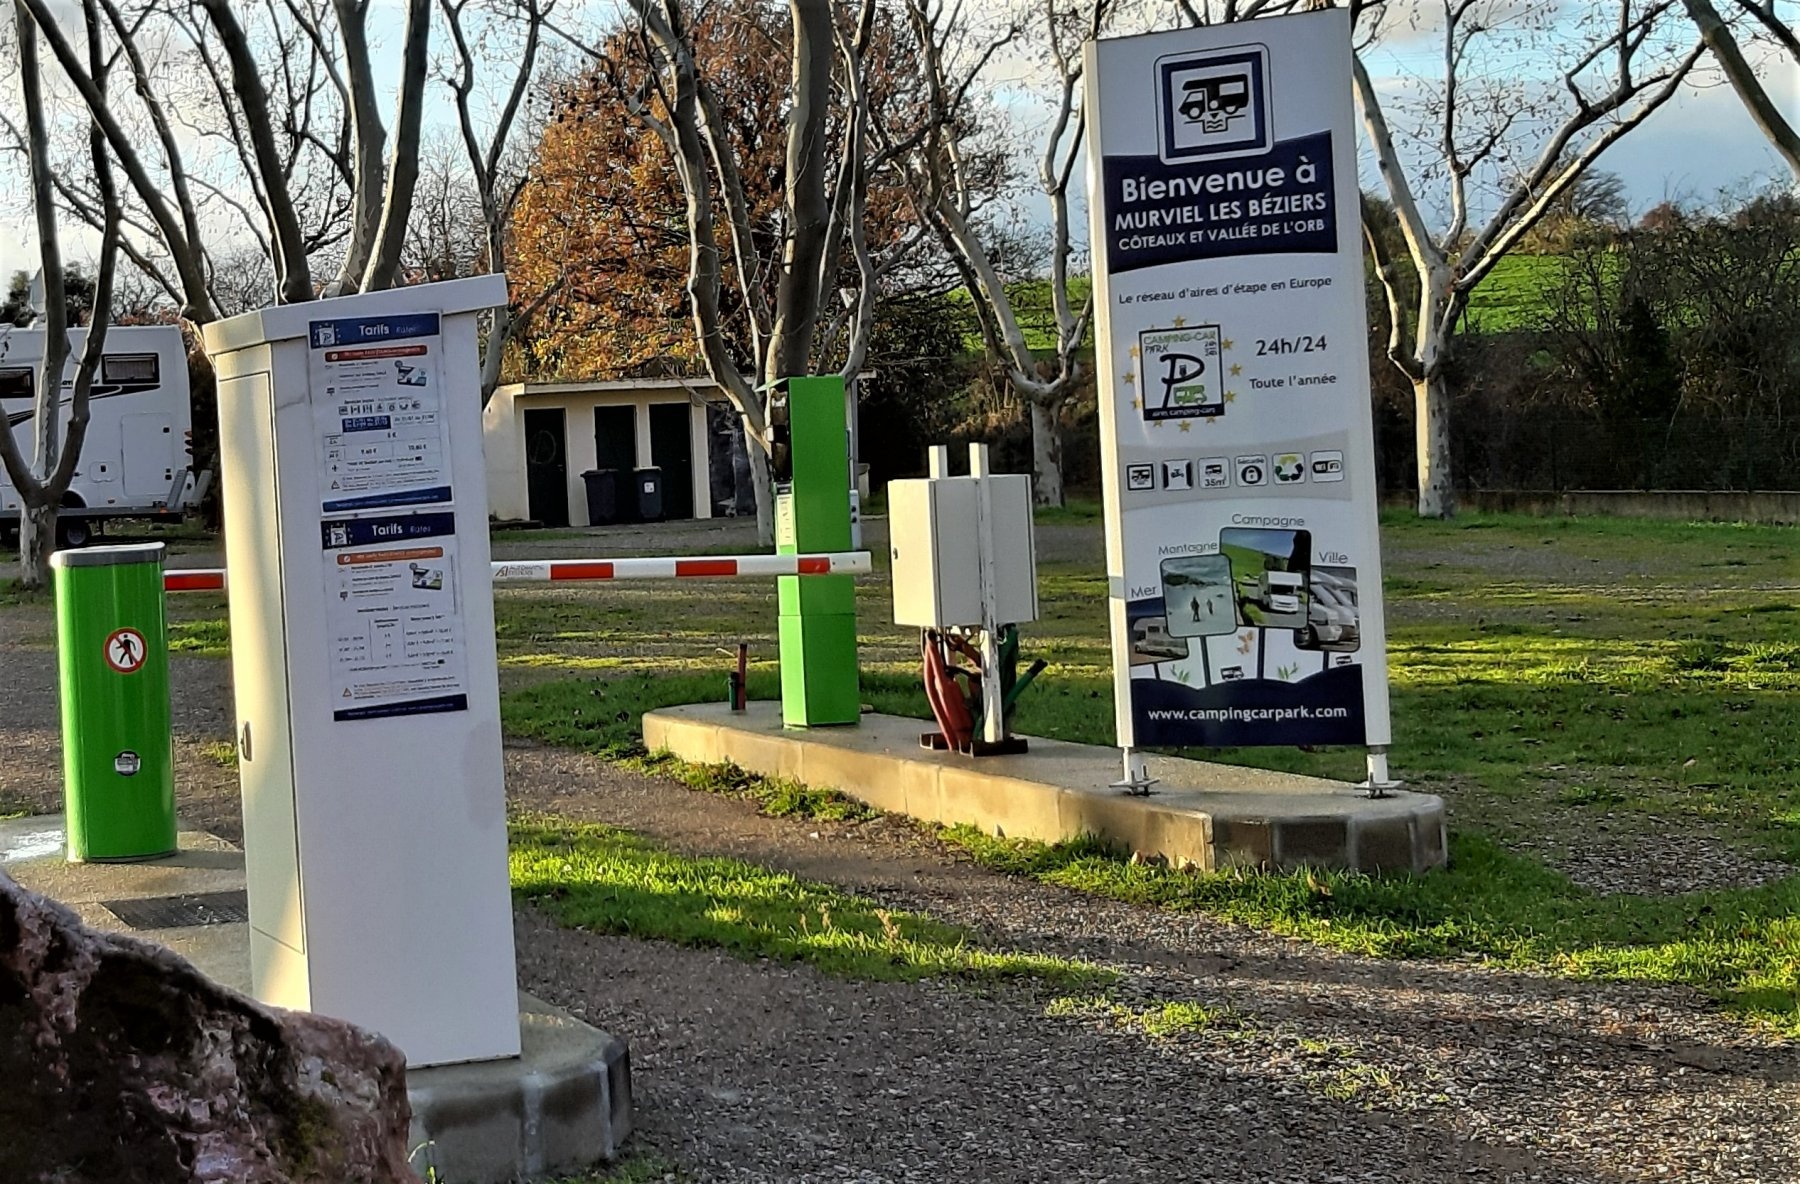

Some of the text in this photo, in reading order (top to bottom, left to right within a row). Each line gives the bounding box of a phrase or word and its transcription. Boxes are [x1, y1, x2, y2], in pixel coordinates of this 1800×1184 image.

[1122, 156, 1316, 202] Bienvenue à
[1114, 192, 1327, 231] MURVIEL LES BÉZIERS
[1118, 219, 1325, 250] CÔTEAUX ET VALLÉE DE L'ORB
[1119, 294, 1133, 304] Le
[1179, 286, 1218, 299] d'aires
[1271, 281, 1286, 291] en
[1290, 277, 1332, 290] Europe
[359, 324, 390, 336] Tarifs
[1256, 335, 1328, 356] 24h/24
[1250, 373, 1337, 390] Toute l'année
[1232, 513, 1305, 528] Campagne
[372, 523, 403, 536] Tarifs
[1158, 541, 1218, 556] Montagne
[1319, 552, 1348, 564] Ville
[1131, 585, 1158, 599] Mer
[1148, 705, 1347, 722] www.campingcarpark.com
